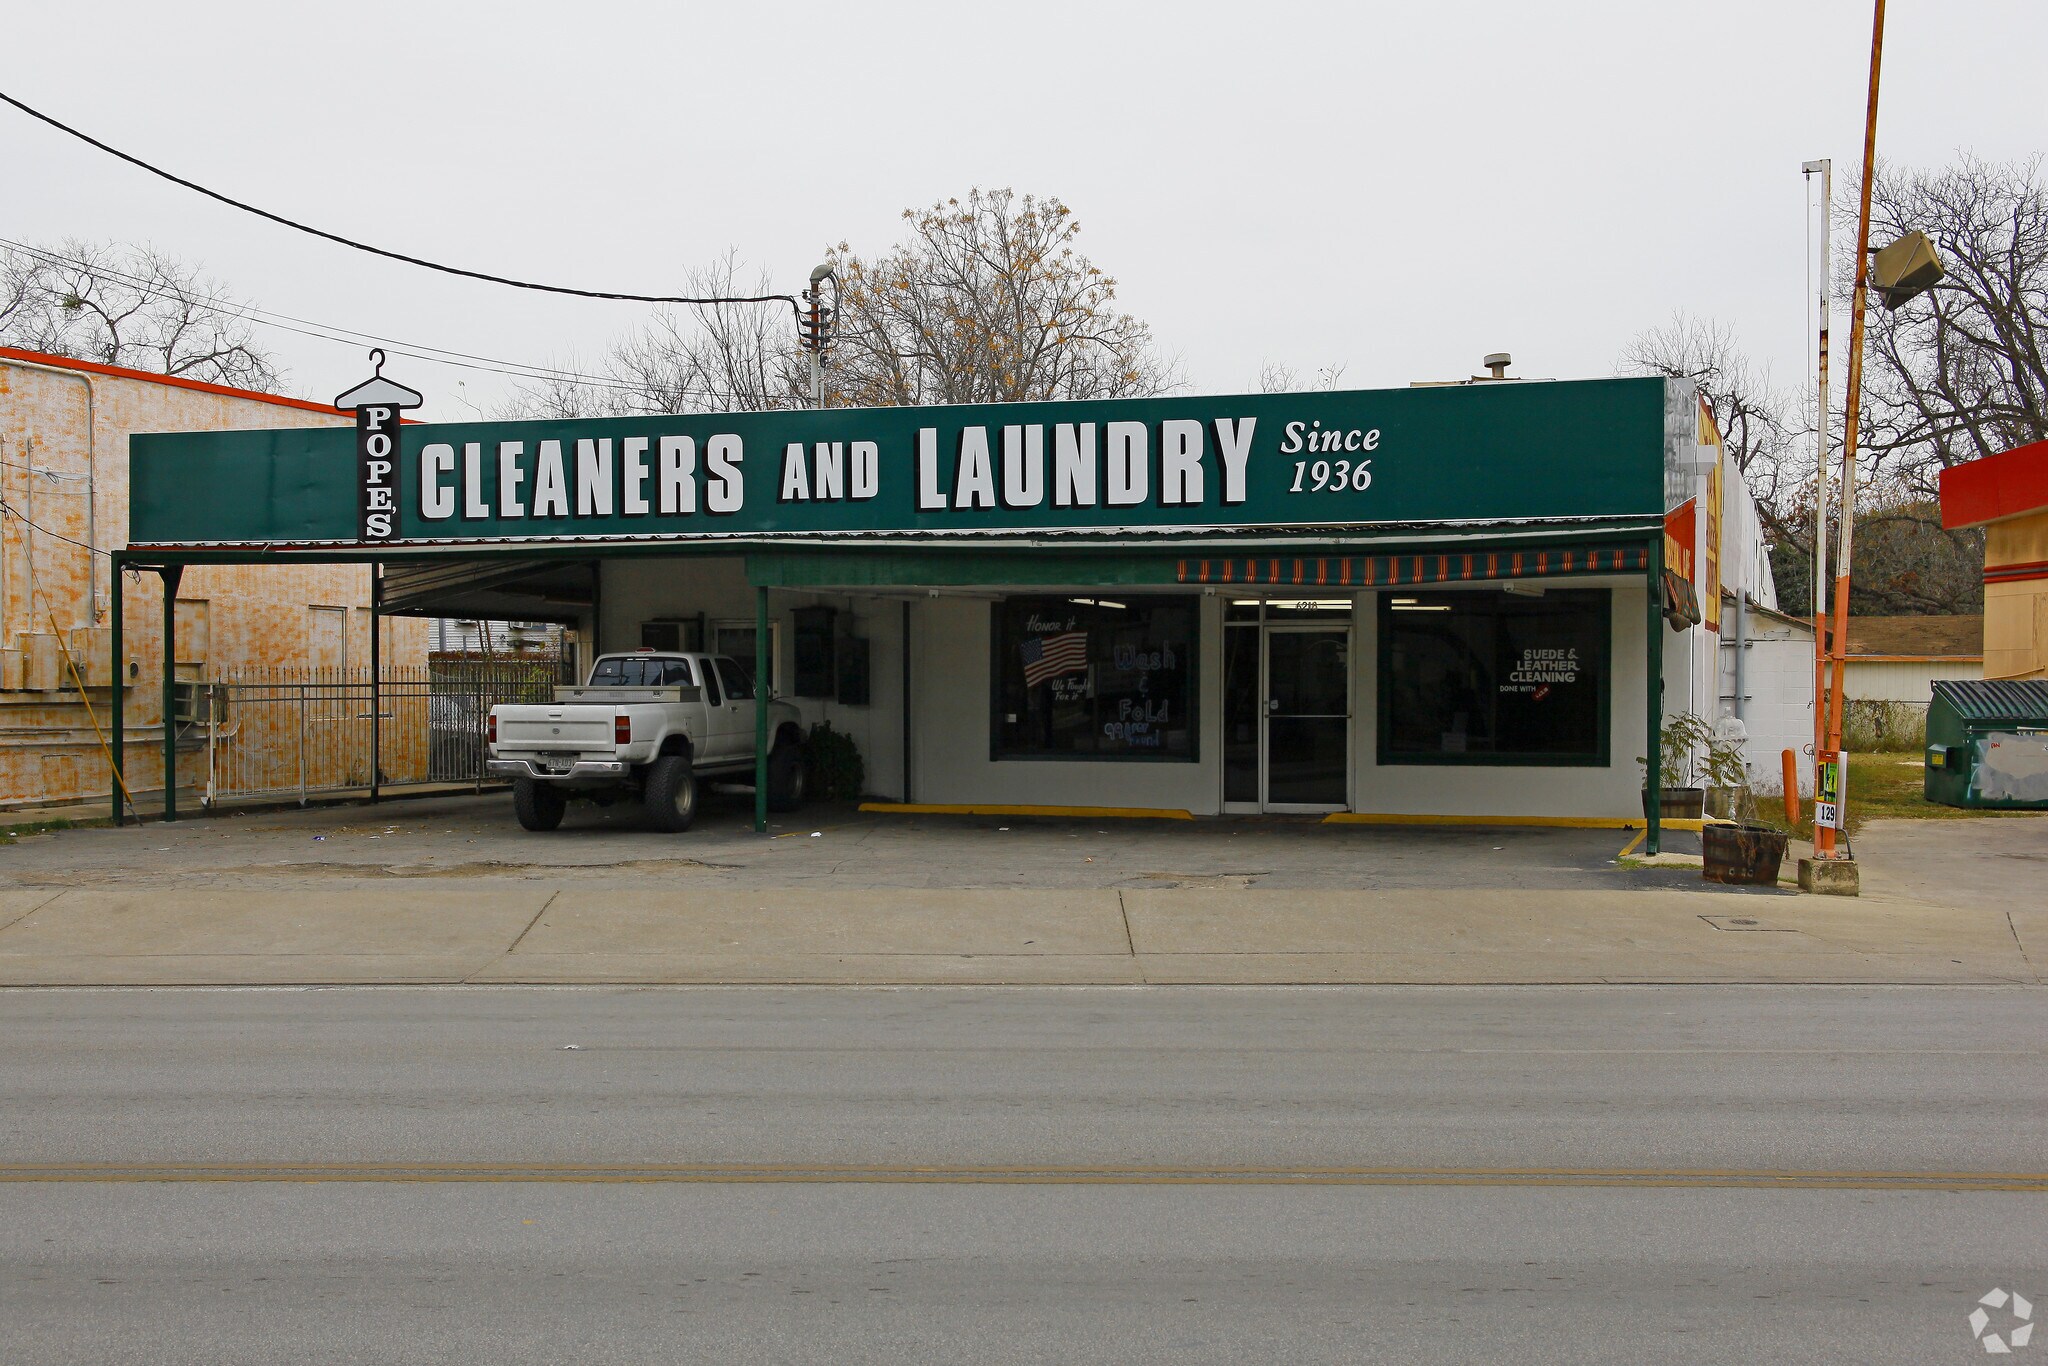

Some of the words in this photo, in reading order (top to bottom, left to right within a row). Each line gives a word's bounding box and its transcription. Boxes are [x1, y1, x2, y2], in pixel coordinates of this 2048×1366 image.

[1280, 420, 1381, 453] Since
[366, 408, 397, 537] POPE'S
[421, 433, 744, 519] CLEANERS
[782, 440, 879, 499] AND
[919, 416, 1257, 510] LAUNDRY
[1289, 459, 1372, 492] 1936
[1296, 601, 1318, 611] 6218
[1066, 615, 1076, 631] it
[1113, 641, 1176, 671] Wash
[1523, 648, 1565, 660] SUEDE
[1567, 648, 1579, 660] &
[1516, 660, 1580, 671] LEATHER
[1509, 671, 1576, 683] CLEANING
[1499, 685, 1518, 693] DONE
[1519, 685, 1537, 693] WITH
